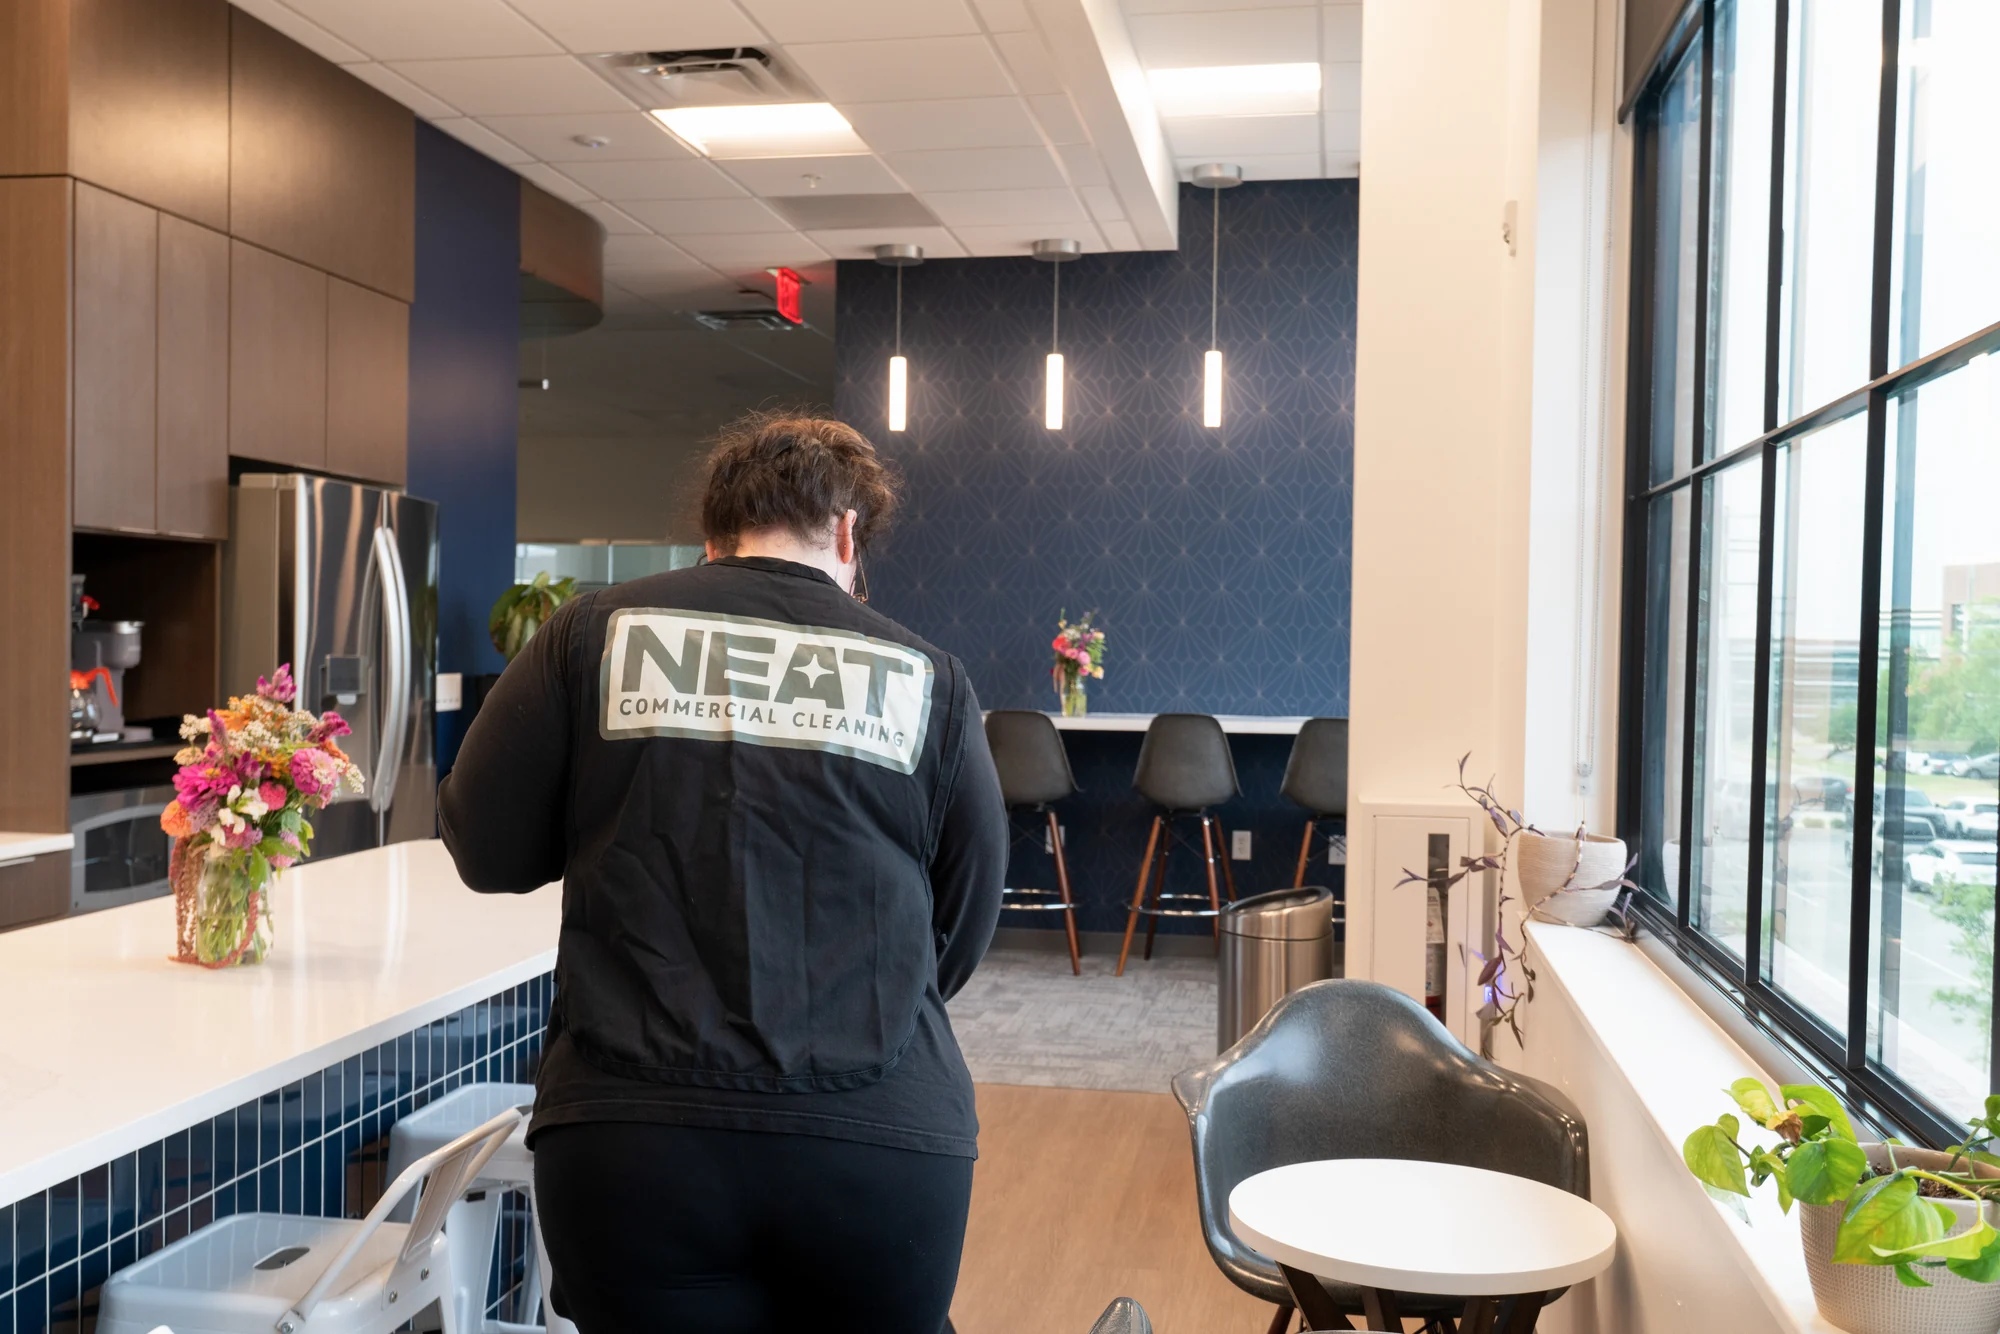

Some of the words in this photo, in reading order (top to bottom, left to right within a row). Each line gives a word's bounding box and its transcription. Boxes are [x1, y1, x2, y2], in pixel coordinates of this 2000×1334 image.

[621, 625, 914, 718] NEAT
[619, 698, 776, 724] COMMERCIAL
[792, 712, 905, 748] CLEANING
